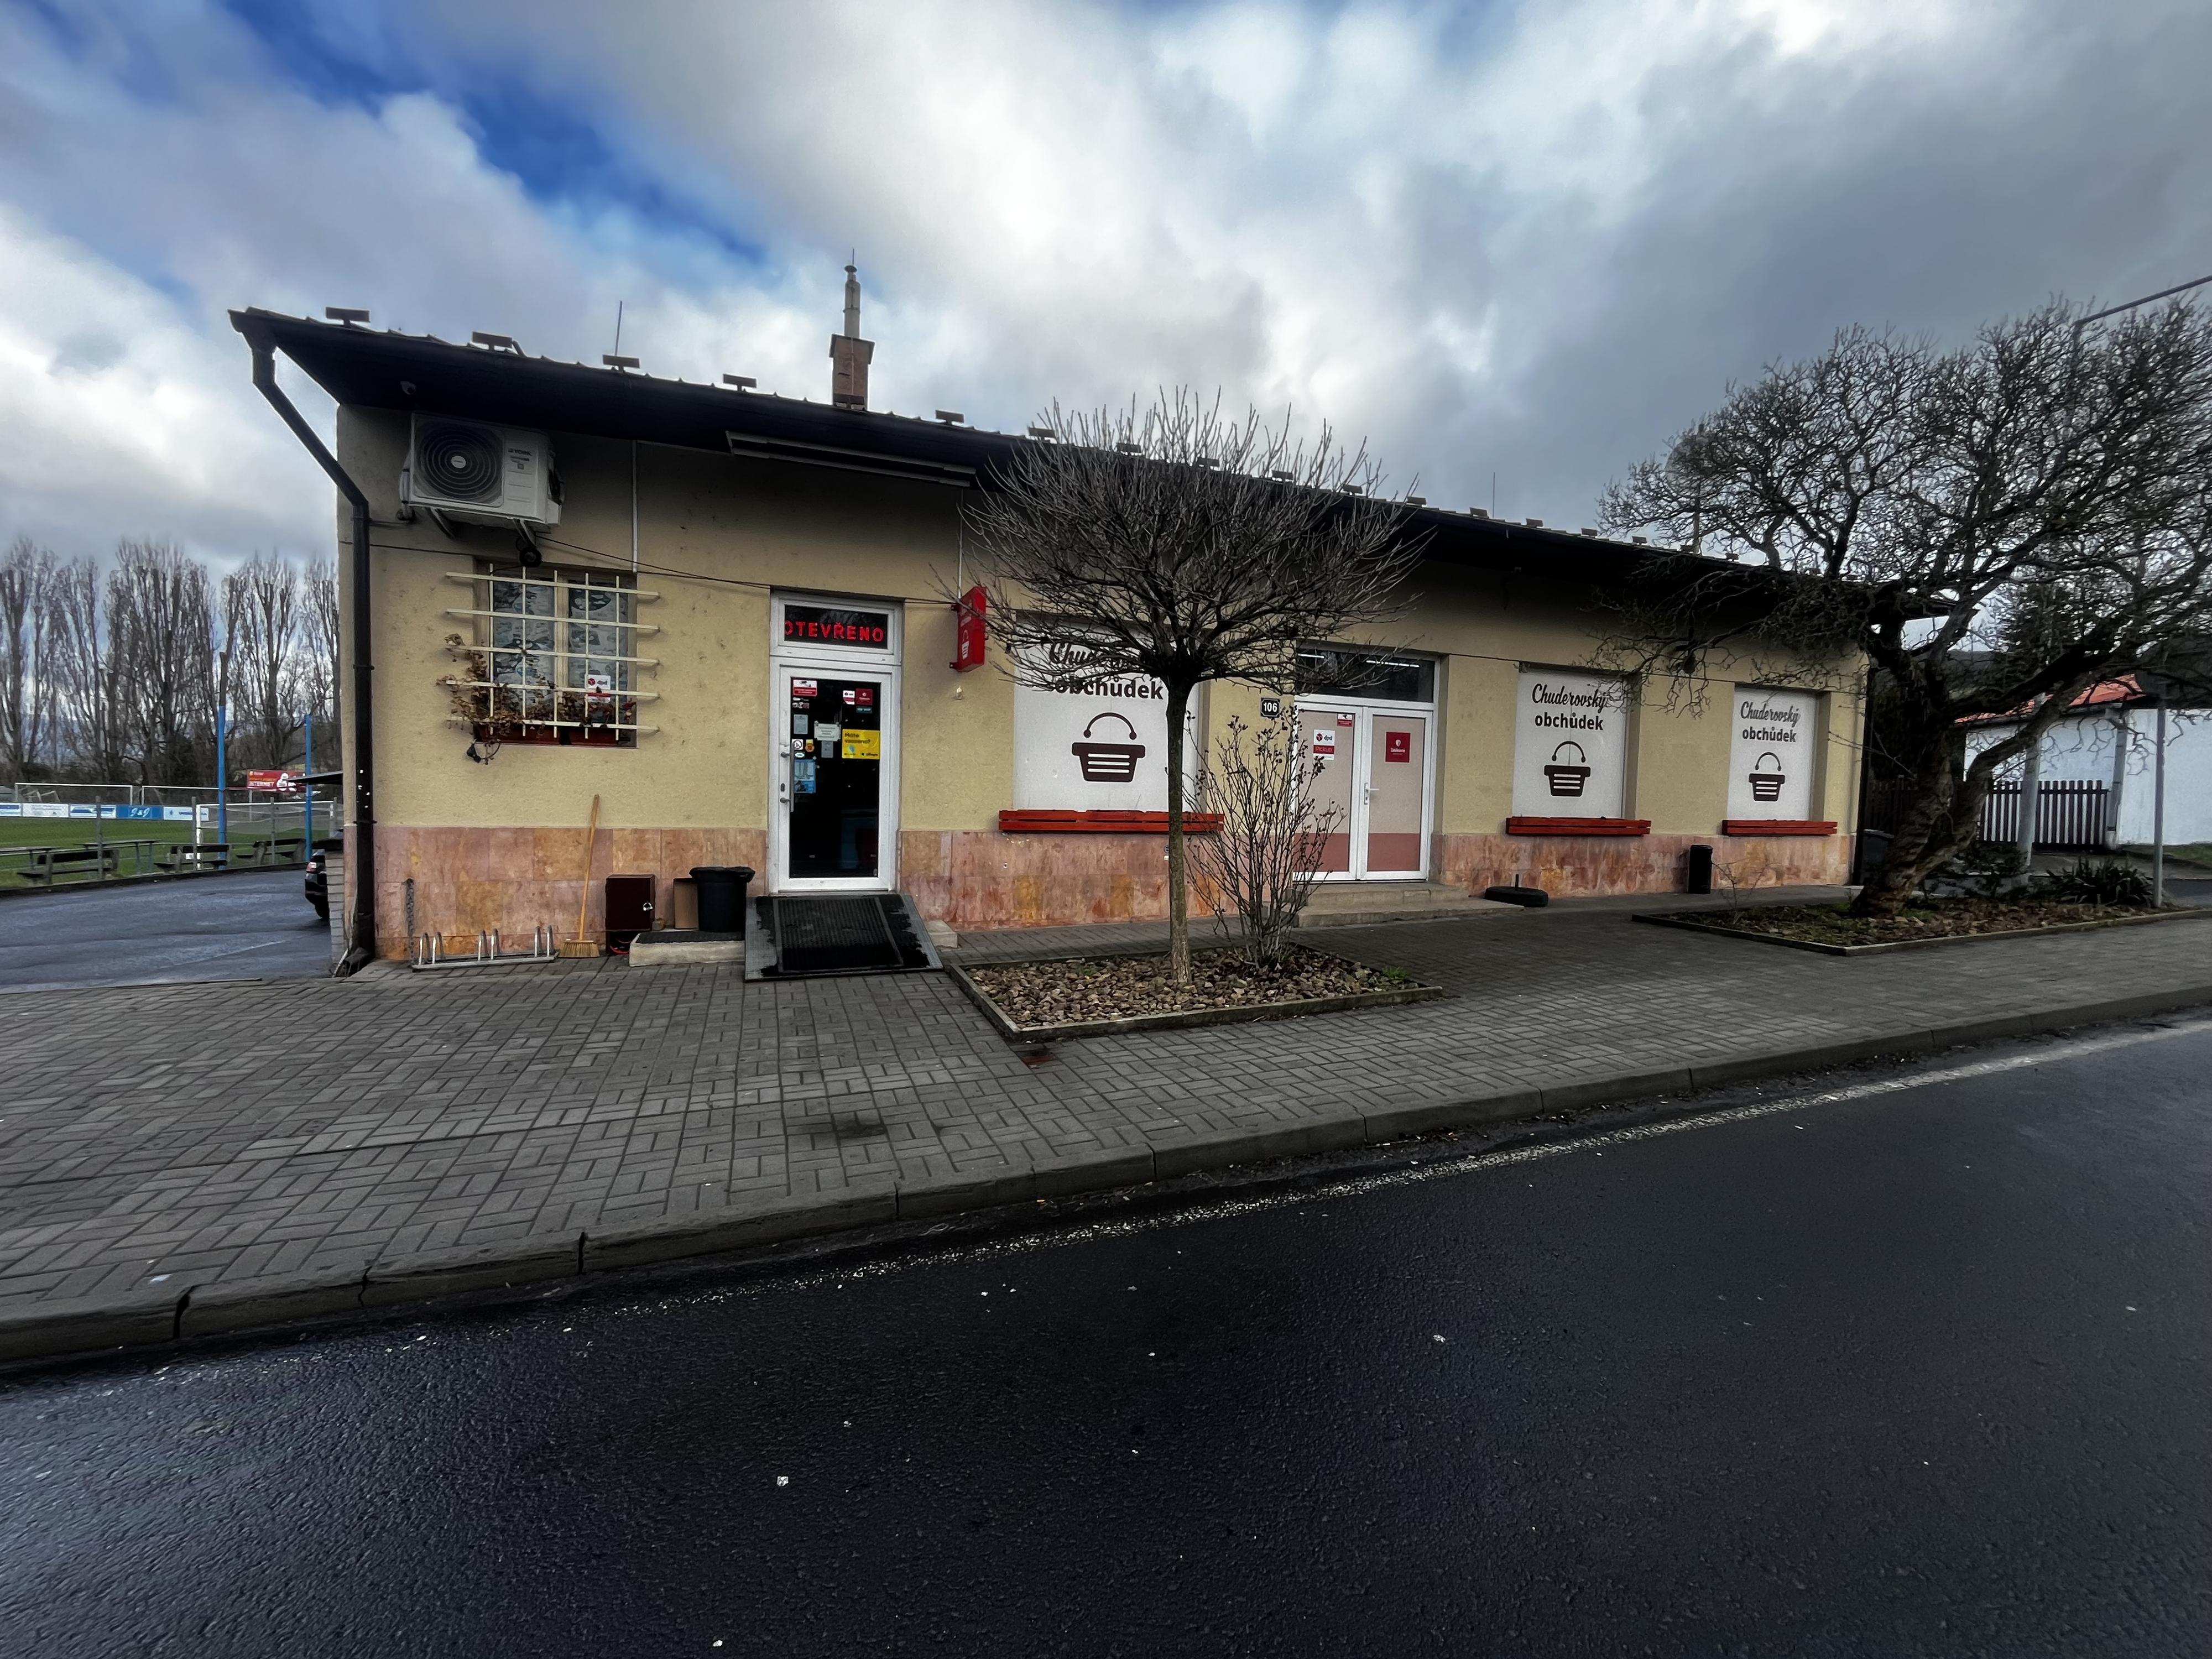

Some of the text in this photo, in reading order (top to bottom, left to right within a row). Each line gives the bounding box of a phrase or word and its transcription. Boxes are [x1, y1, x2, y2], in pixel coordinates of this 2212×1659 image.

[784, 620, 884, 642] OTEVŘENO
[1263, 702, 1278, 713] 106
[1740, 701, 1801, 728] Chuderovský
[1535, 712, 1604, 731] obchůdek
[1742, 726, 1797, 743] obchůdek
